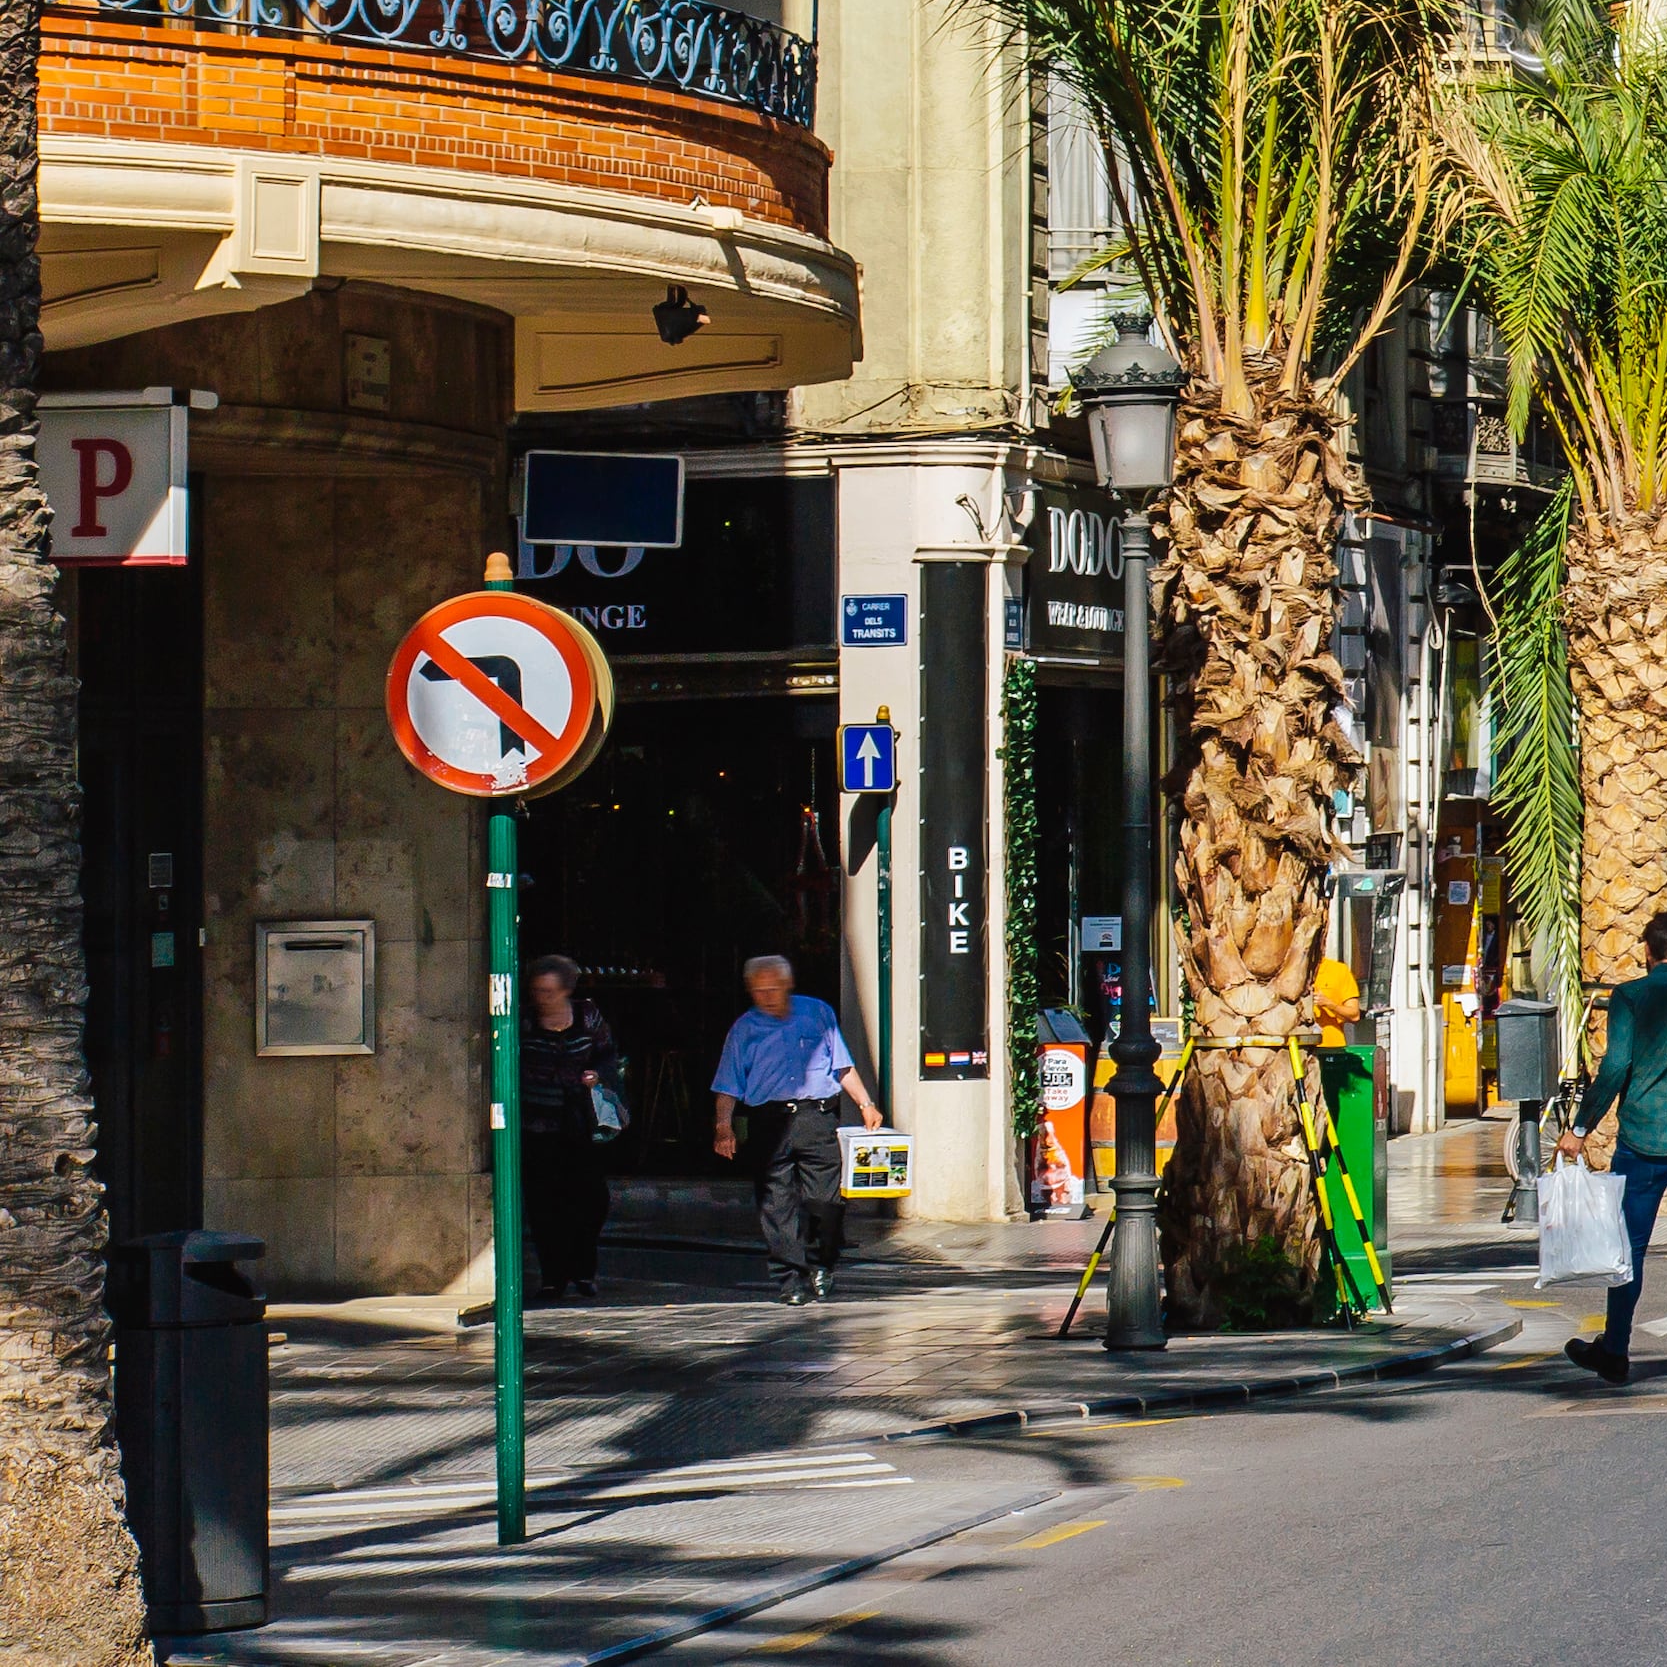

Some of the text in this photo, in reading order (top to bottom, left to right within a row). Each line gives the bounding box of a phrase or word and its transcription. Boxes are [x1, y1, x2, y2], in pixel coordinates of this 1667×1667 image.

[71, 438, 133, 537] P
[1047, 506, 1124, 580] DODO
[861, 602, 891, 611] CARRER
[864, 616, 883, 626] DELS
[851, 628, 897, 639] TRANSITS
[948, 846, 970, 955] BIKE
